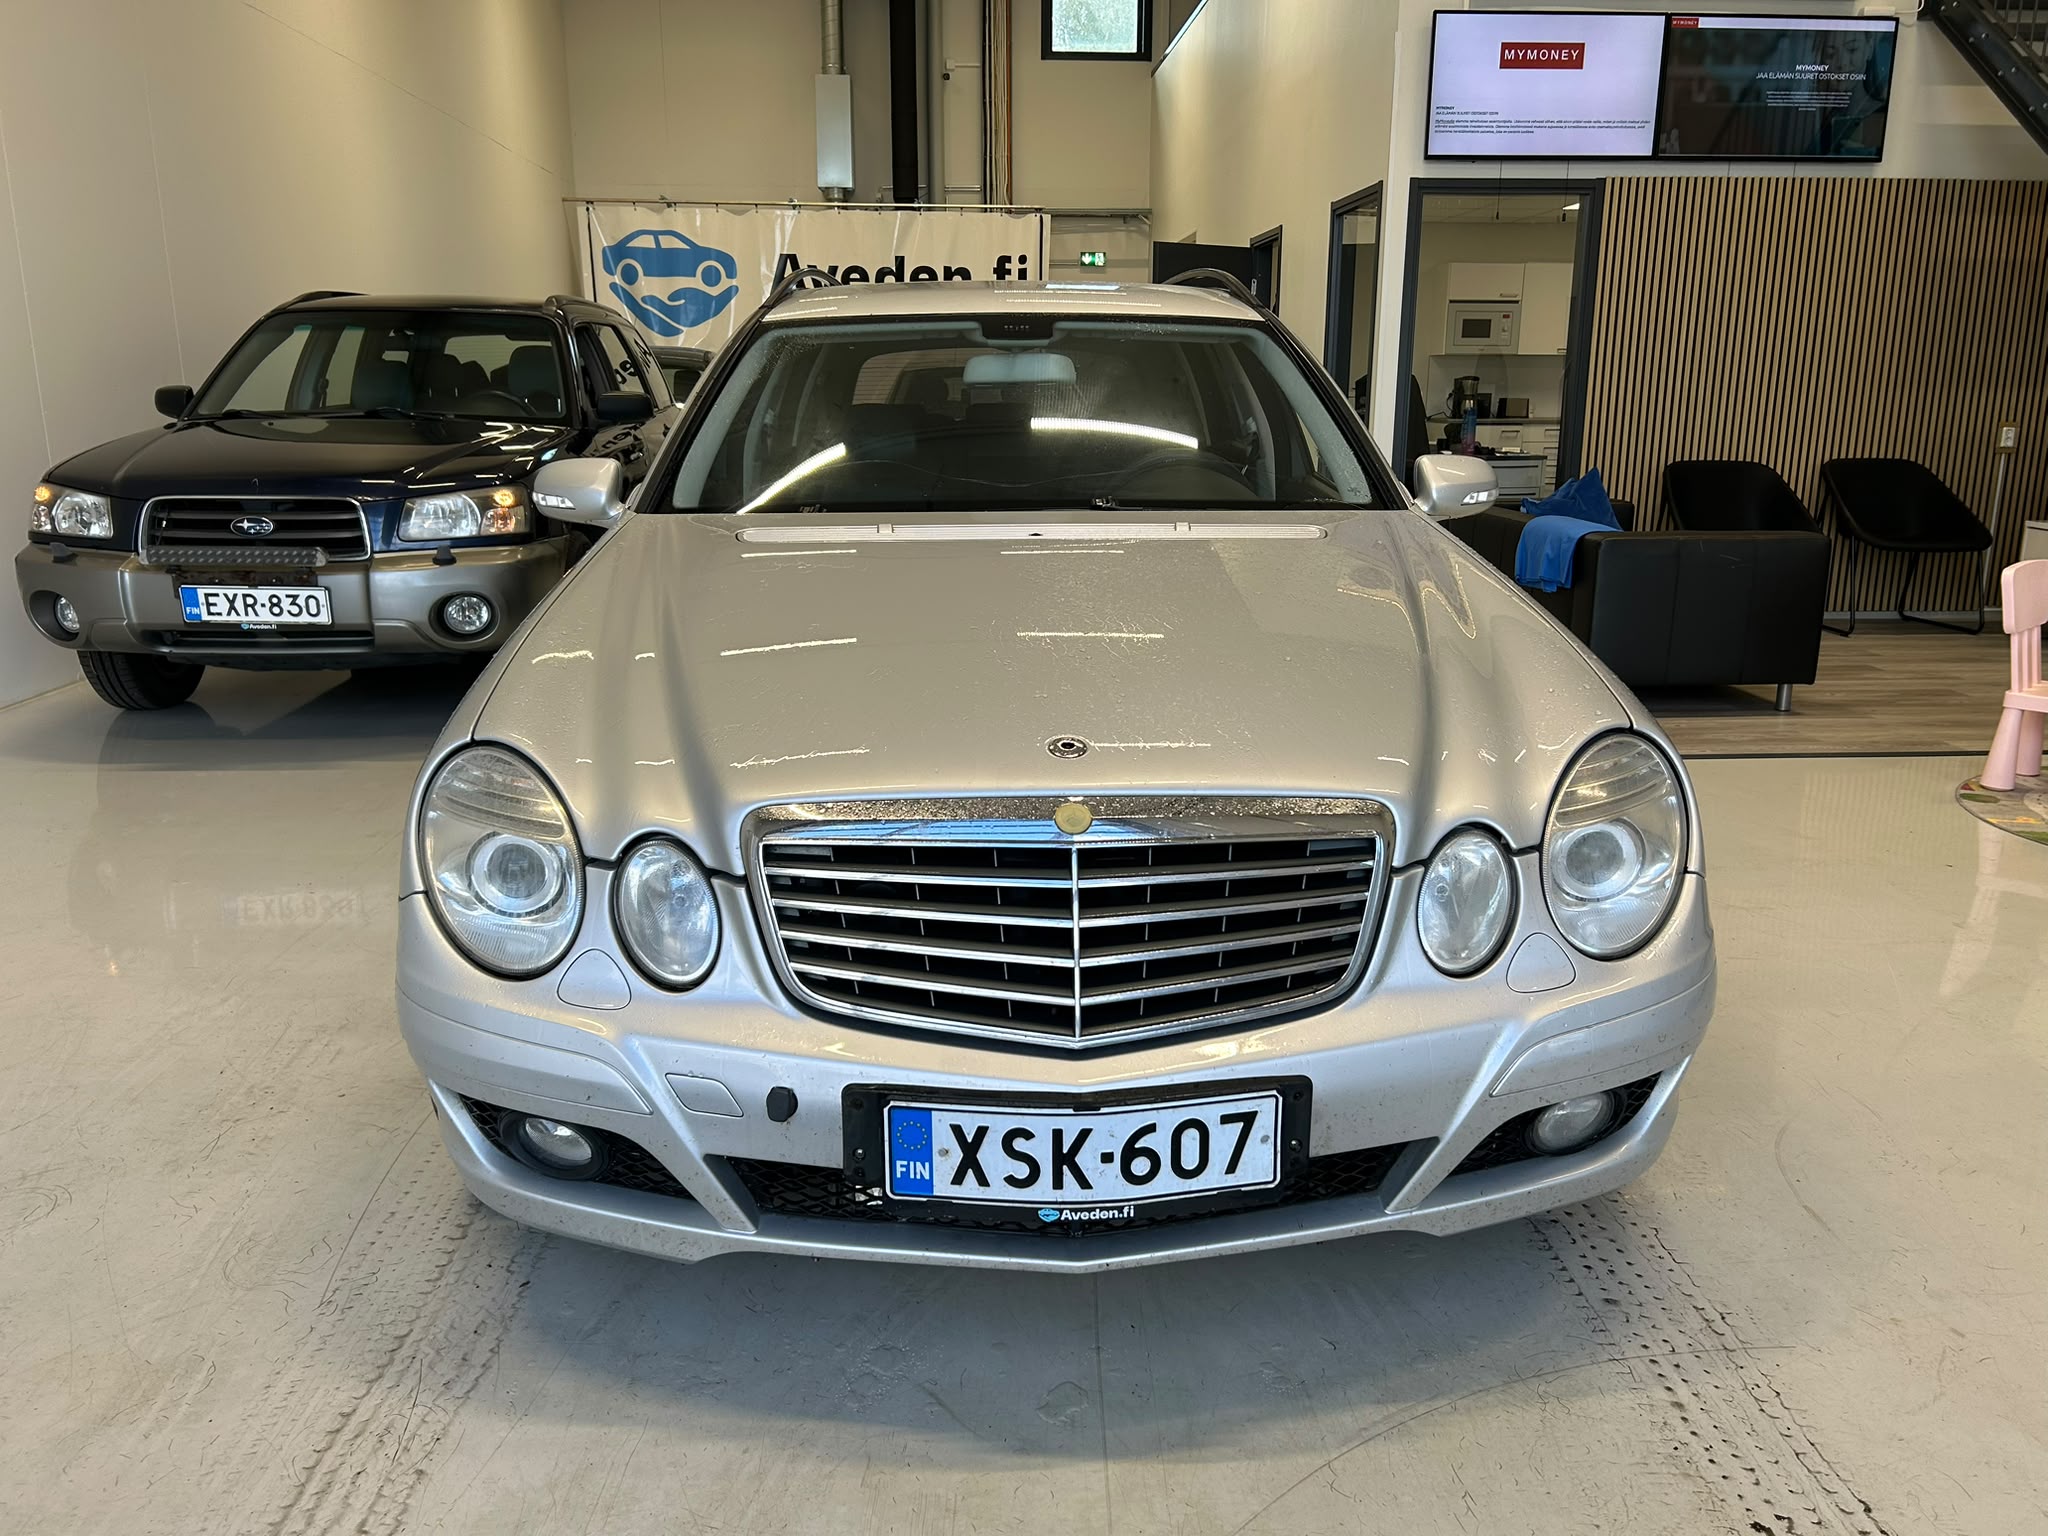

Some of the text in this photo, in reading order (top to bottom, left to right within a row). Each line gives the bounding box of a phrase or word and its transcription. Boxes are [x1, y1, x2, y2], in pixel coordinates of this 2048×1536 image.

[1504, 49, 1580, 61] MYMONEY
[1795, 64, 1830, 72] MYMONEY
[769, 253, 1028, 290] Avedenfi
[186, 606, 200, 615] FIN
[203, 592, 321, 618] EXR-830
[949, 1110, 1259, 1190] XSK-607
[895, 1160, 930, 1180] FIN
[1060, 1206, 1135, 1222] Aveden.fi
